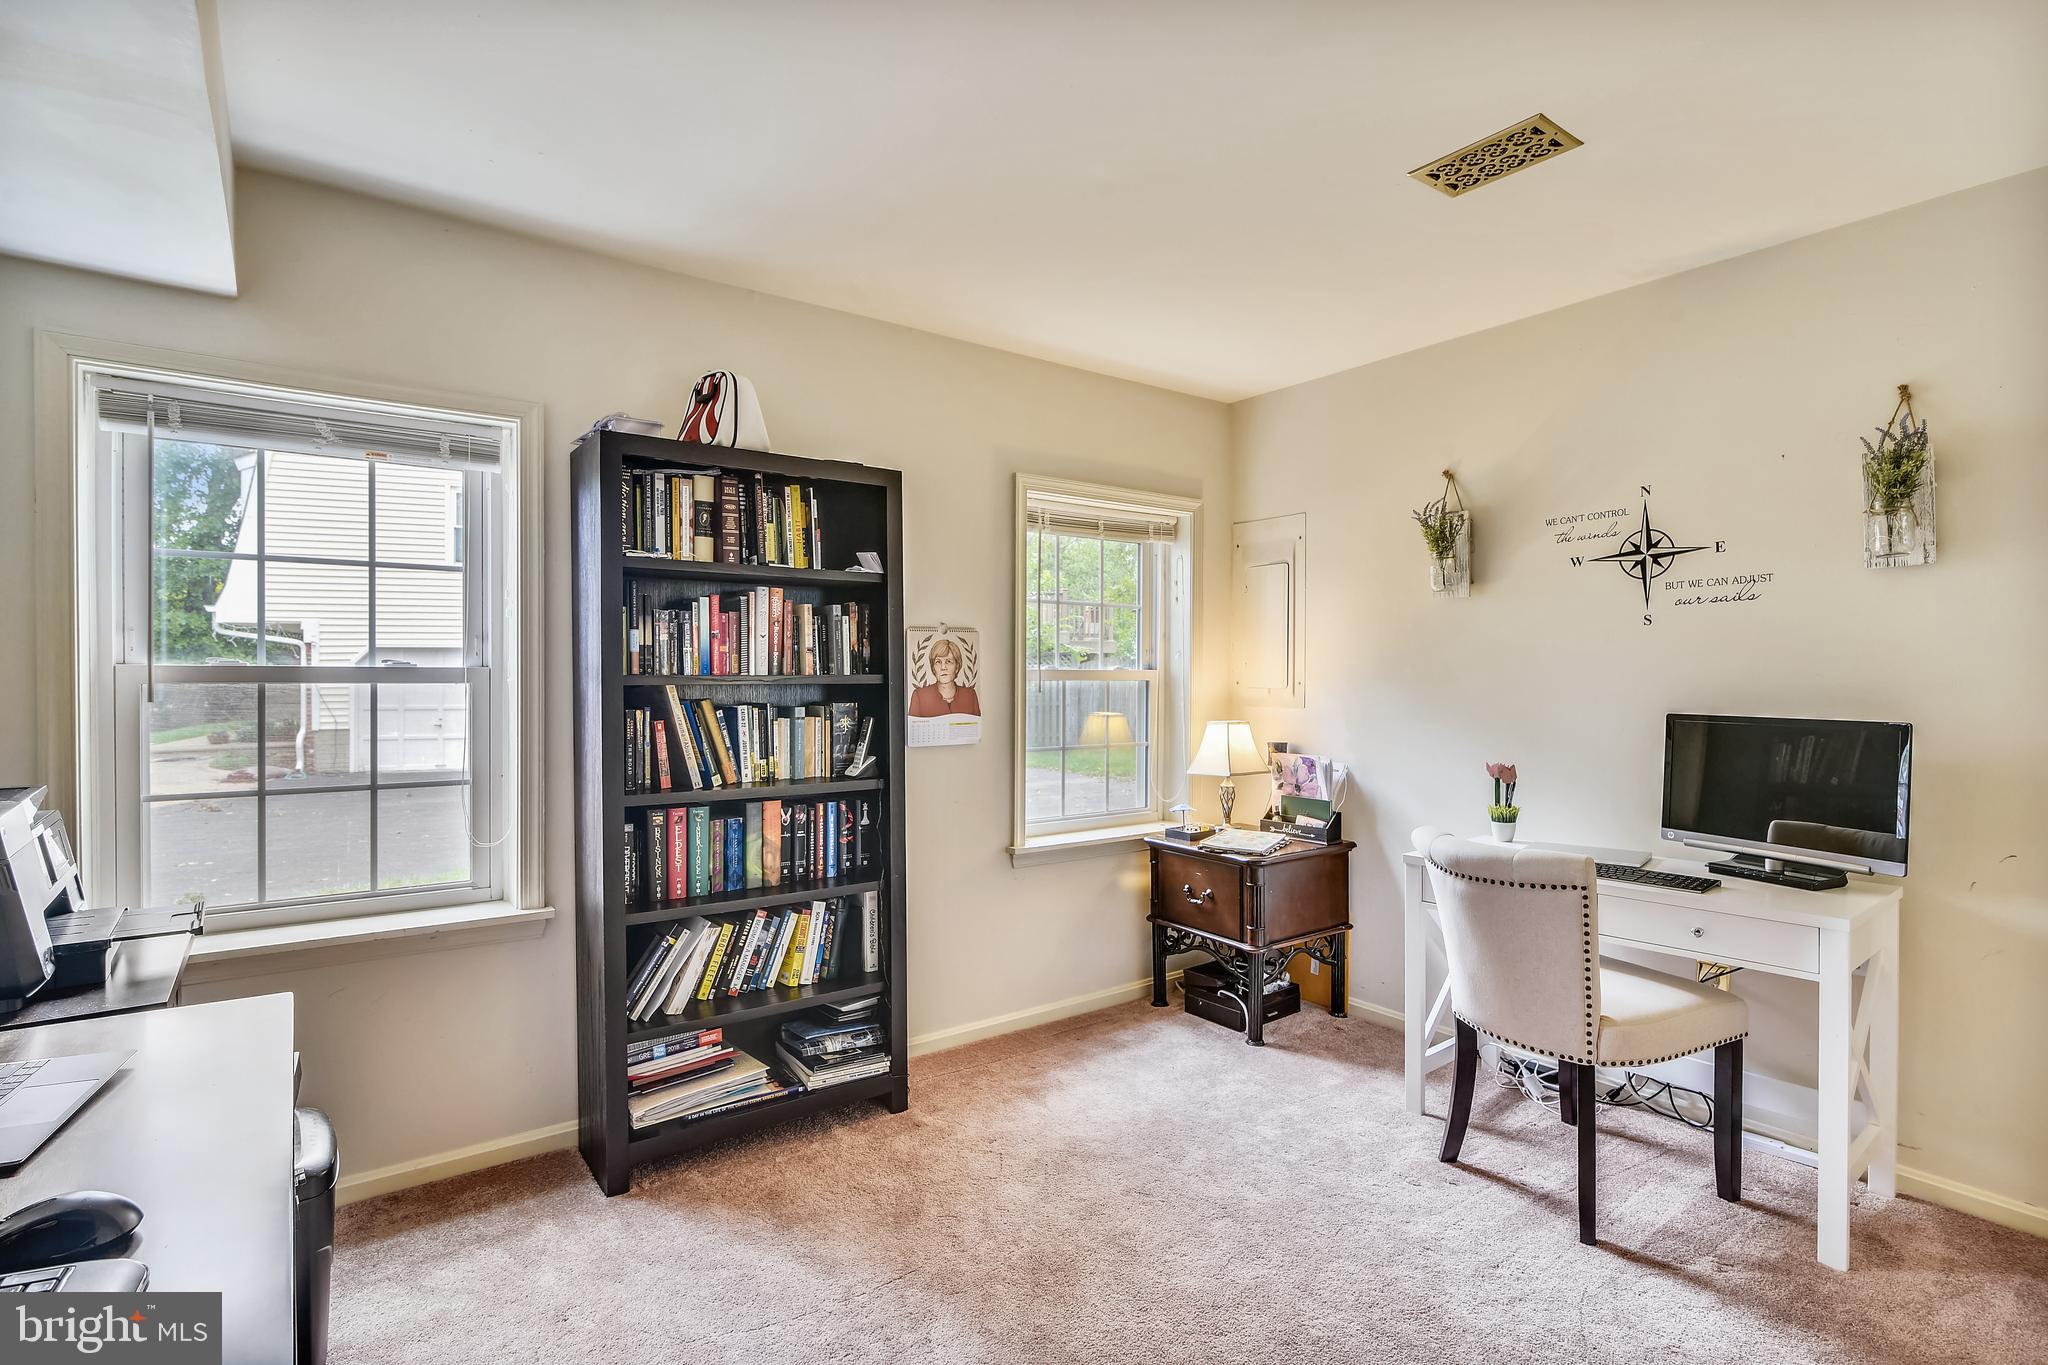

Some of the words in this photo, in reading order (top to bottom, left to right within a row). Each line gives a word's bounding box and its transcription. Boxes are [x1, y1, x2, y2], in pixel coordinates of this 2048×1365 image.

[1640, 484, 1651, 497] N
[1545, 518, 1558, 527] WE
[1560, 514, 1585, 526] CAN'T
[1587, 508, 1630, 521] CONTROL
[1554, 525, 1575, 544] the
[1577, 521, 1622, 541] winds
[1714, 540, 1727, 553] E
[1570, 556, 1586, 567] W
[1665, 580, 1685, 591] BUT
[1688, 578, 1704, 589] WE
[1706, 577, 1729, 587] CAN
[1731, 573, 1774, 586] ADJUST
[1674, 595, 1709, 607] our
[1709, 579, 1762, 604] sails
[1643, 614, 1653, 626] S
[681, 741, 693, 761] Abuse
[1282, 823, 1302, 836] believe
[675, 826, 683, 872] ELDEST
[742, 919, 752, 935] CYBER
[745, 918, 761, 949] BECOMING
[774, 921, 787, 948] EXCEPTIONAL
[714, 932, 728, 957] GHOST
[738, 934, 746, 946] WAR
[704, 959, 719, 983] FLEET
[734, 953, 749, 980] MANAGER
[637, 1050, 651, 1060] GRE
[773, 1089, 788, 1097] FORCES
